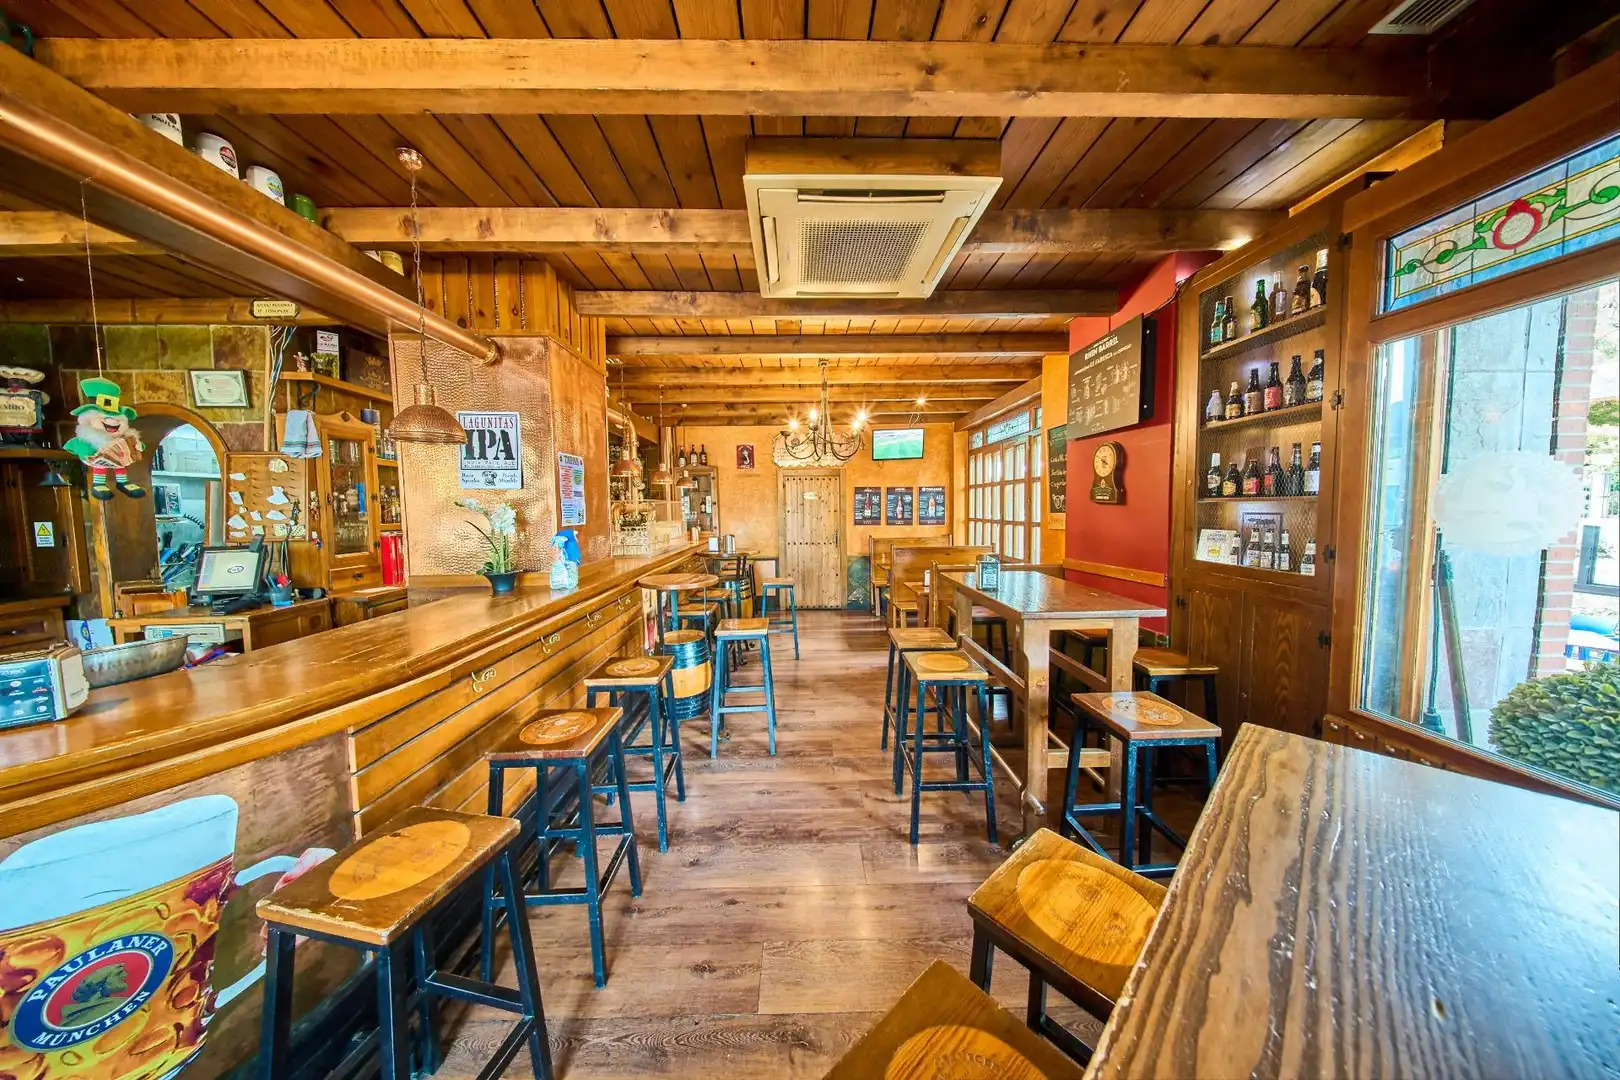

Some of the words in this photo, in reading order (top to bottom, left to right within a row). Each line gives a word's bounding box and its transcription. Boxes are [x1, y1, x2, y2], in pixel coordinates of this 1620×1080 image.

[463, 416, 514, 429] LAGUNITAS
[463, 429, 516, 460] IPA
[27, 935, 168, 1003] PAULANER
[31, 990, 150, 1046] MÜNCHEN
